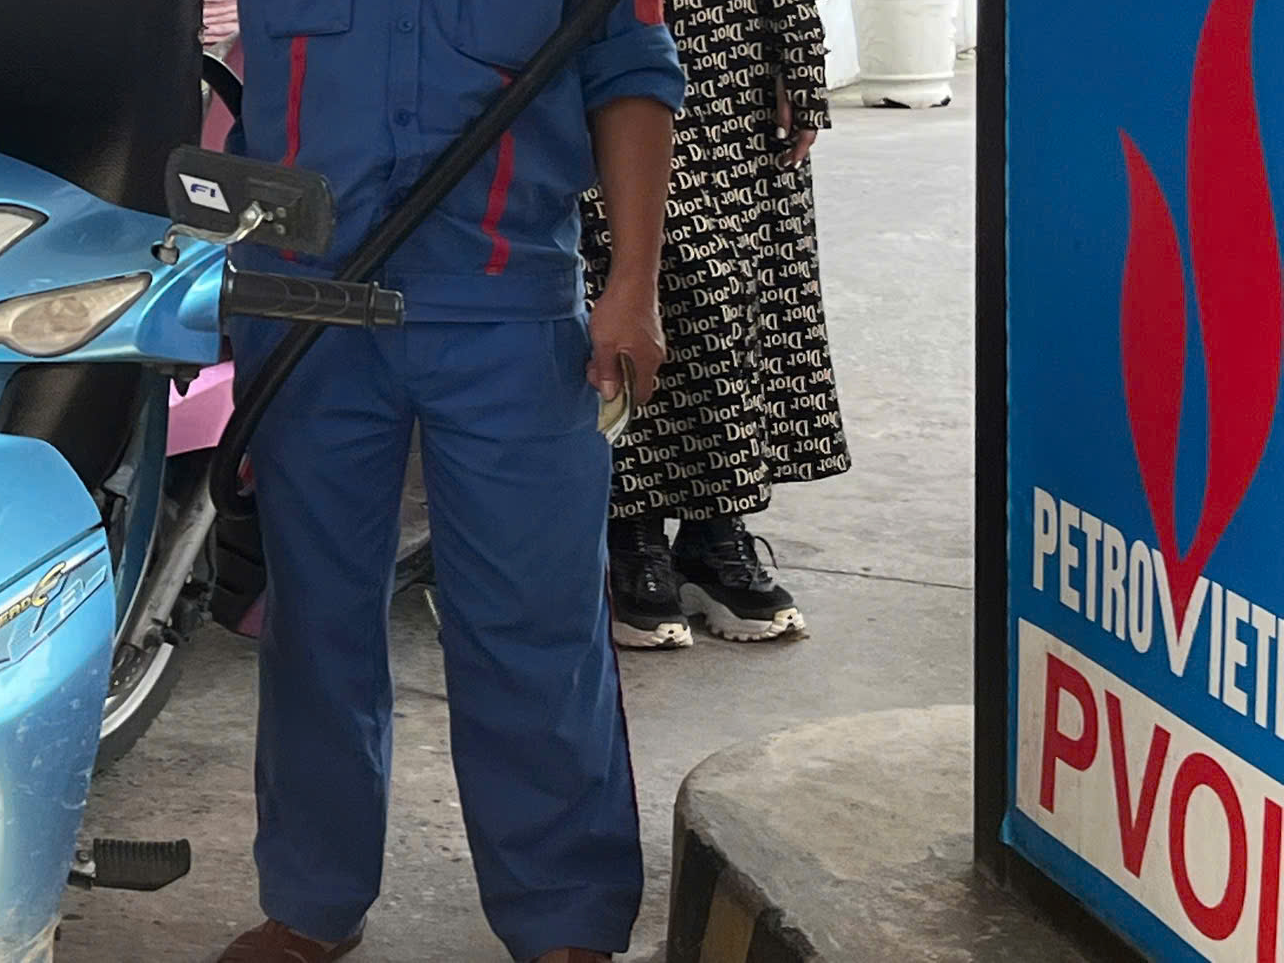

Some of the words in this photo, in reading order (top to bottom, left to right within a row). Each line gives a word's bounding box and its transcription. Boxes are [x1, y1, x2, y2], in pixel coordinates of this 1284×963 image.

[688, 6, 725, 26] Dior
[710, 23, 743, 42] Dior
[692, 52, 727, 71] Dior
[729, 42, 762, 60] Dior
[787, 65, 824, 84] Dior
[666, 199, 703, 218] Dior
[679, 240, 717, 262] Dior
[760, 242, 795, 261] Dior
[779, 261, 811, 278] Dior
[666, 269, 707, 291] Dior
[693, 286, 730, 307] Dior
[760, 287, 798, 305] Dior
[678, 316, 719, 336] Dior
[783, 305, 818, 323] Dior
[764, 331, 803, 349] Dior
[665, 344, 701, 363] Dior
[787, 349, 822, 367] Dior
[688, 360, 732, 380] Dior
[767, 375, 807, 393] Dior
[672, 389, 712, 409] Dior
[791, 393, 826, 411] Dior
[654, 417, 696, 435] Dior
[700, 404, 740, 425] Dior
[771, 420, 809, 436] Dior
[637, 445, 680, 464] Dior
[682, 433, 722, 453] Dior
[794, 437, 831, 455] Dior
[621, 472, 663, 492] Dior
[665, 461, 706, 480] Dior
[708, 449, 749, 469] Dior
[774, 463, 812, 479] Dior
[648, 490, 688, 508] Dior
[691, 479, 732, 497] Dior
[716, 494, 758, 514] Dior
